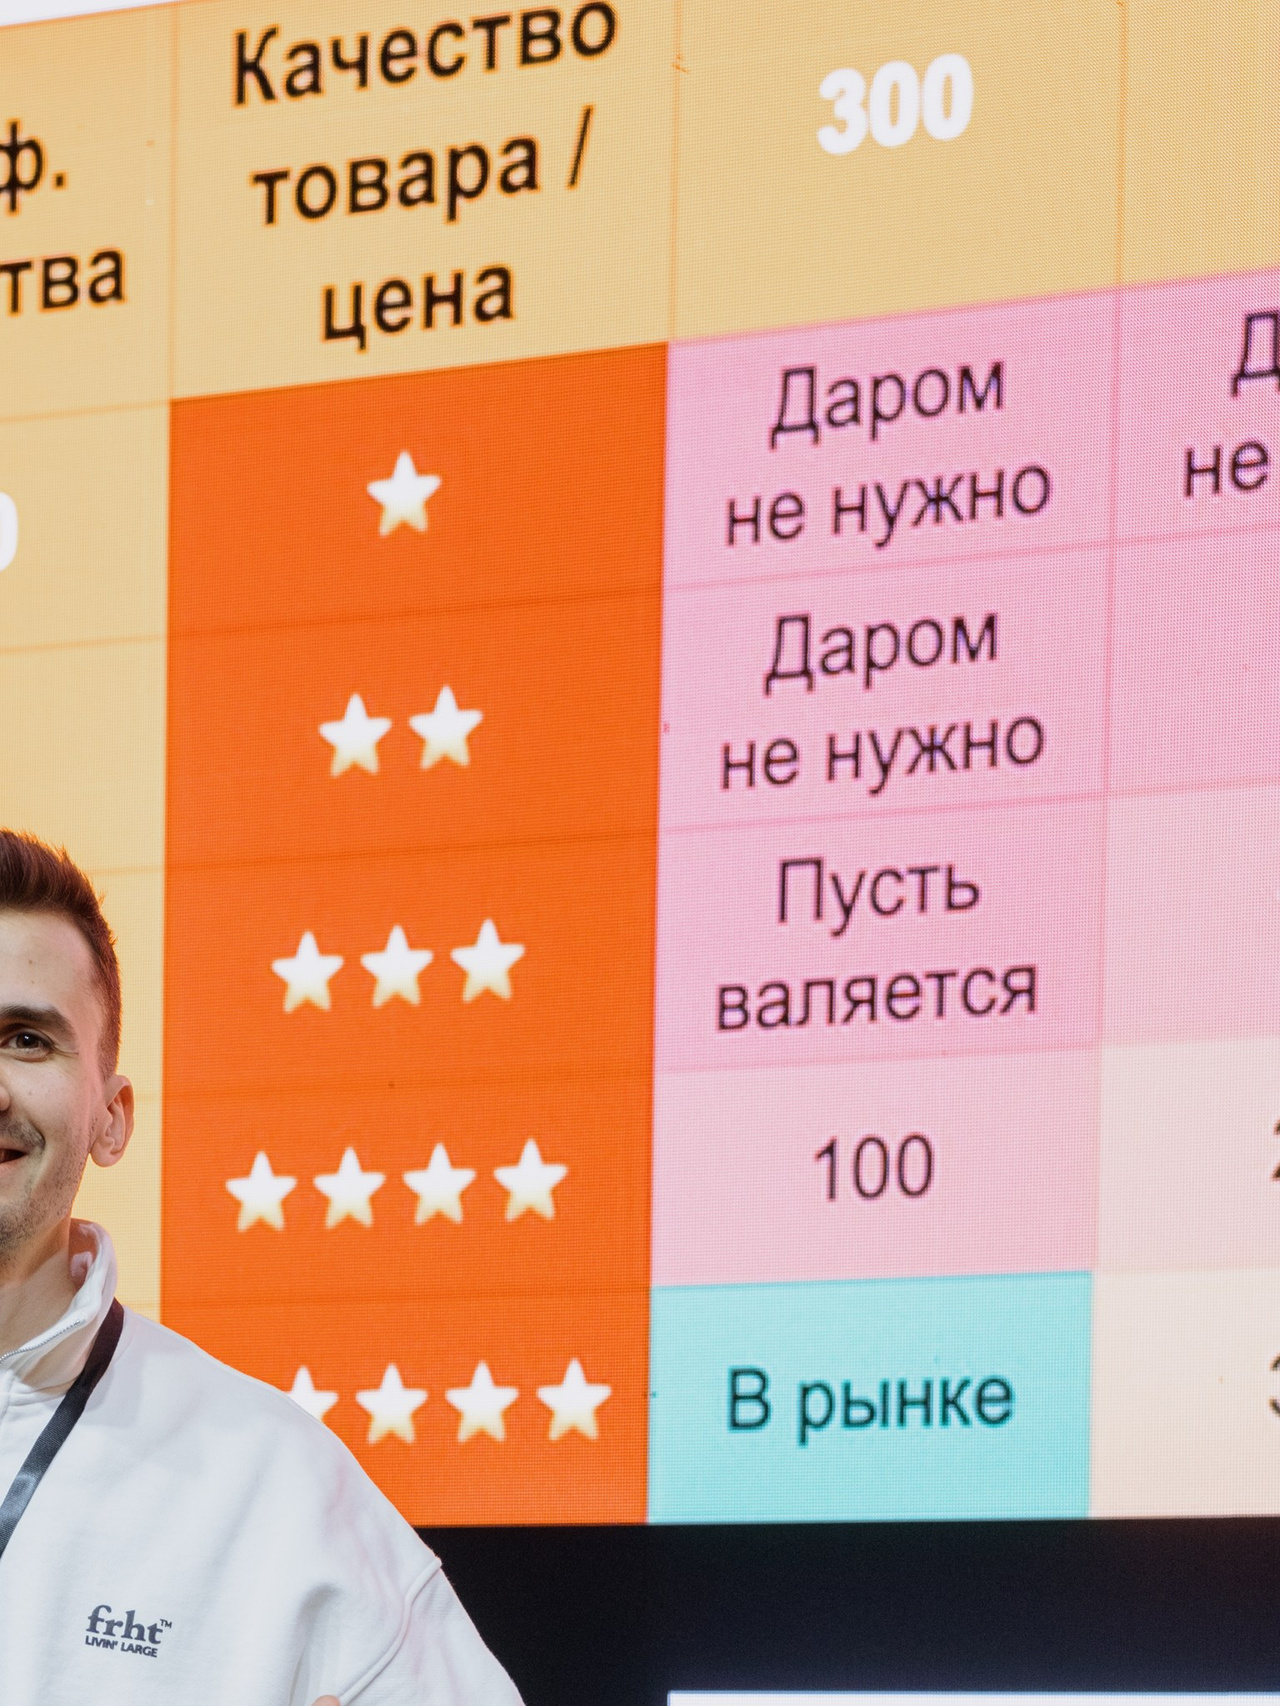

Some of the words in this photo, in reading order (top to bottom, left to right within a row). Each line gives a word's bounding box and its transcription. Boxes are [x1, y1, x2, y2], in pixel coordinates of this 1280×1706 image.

[233, 1, 617, 107] Качество
[817, 53, 974, 156] 300
[252, 134, 540, 226] товара
[322, 263, 514, 353] цена
[770, 361, 1004, 450] Даром
[727, 489, 806, 547] не
[832, 462, 1052, 551] нужно
[1184, 440, 1269, 498] не
[765, 612, 999, 696] Даром
[721, 736, 800, 791] не
[826, 716, 1047, 797] нужно
[778, 857, 981, 937] Пусть
[717, 965, 1039, 1031] валяется
[814, 1134, 936, 1202] 100
[728, 1366, 772, 1432] В
[798, 1374, 1017, 1447] рынке
[85, 1635, 118, 1650] LIVIN'
[120, 1642, 158, 1658] LARGE
